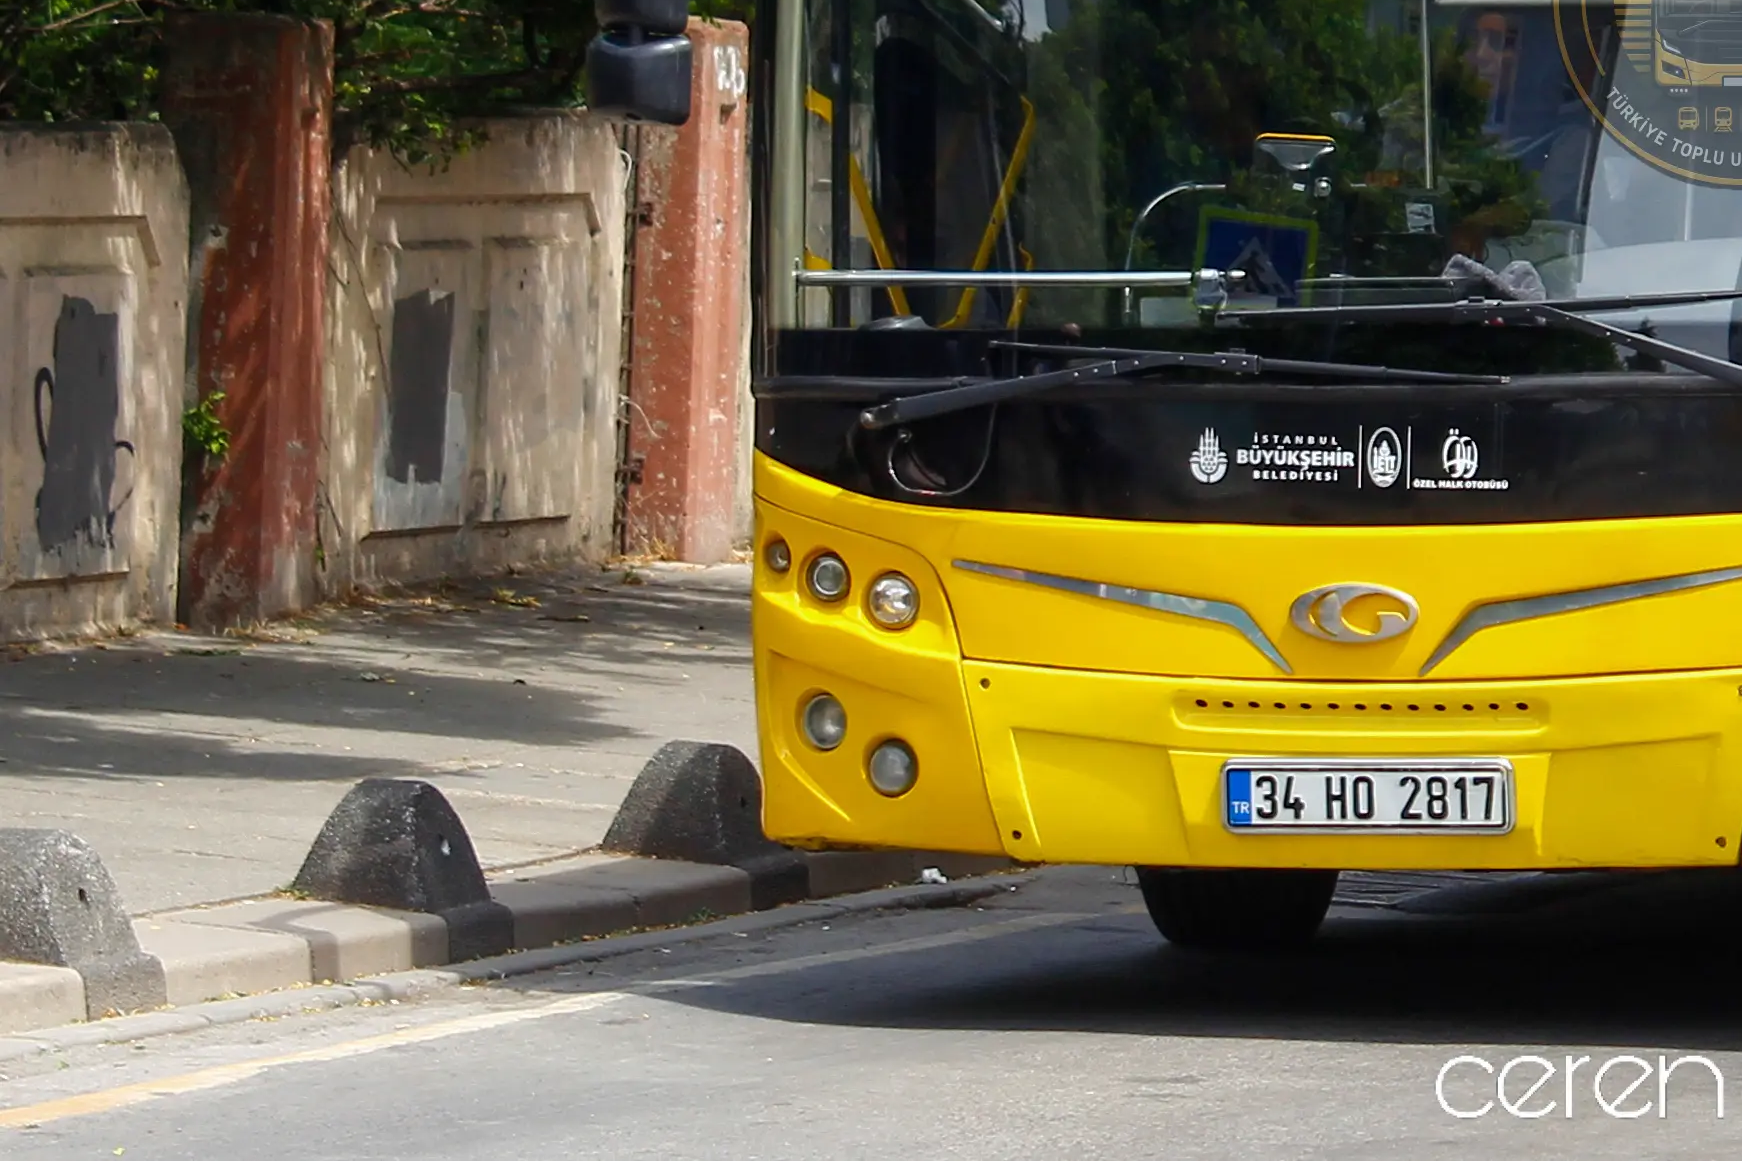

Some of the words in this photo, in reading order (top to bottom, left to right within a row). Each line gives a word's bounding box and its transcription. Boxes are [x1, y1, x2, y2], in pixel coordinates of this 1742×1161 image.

[1253, 431, 1339, 446] İSTANBUL
[1236, 445, 1355, 473] BÜYÜKŞEHİR
[1253, 468, 1339, 482] BELEDİYESİ
[1412, 477, 1437, 489] ÖZEL
[1438, 479, 1464, 489] HALK
[1231, 801, 1251, 815] TR
[1255, 775, 1306, 820] 34
[1325, 775, 1375, 820] HO
[1399, 775, 1496, 820] 2817
